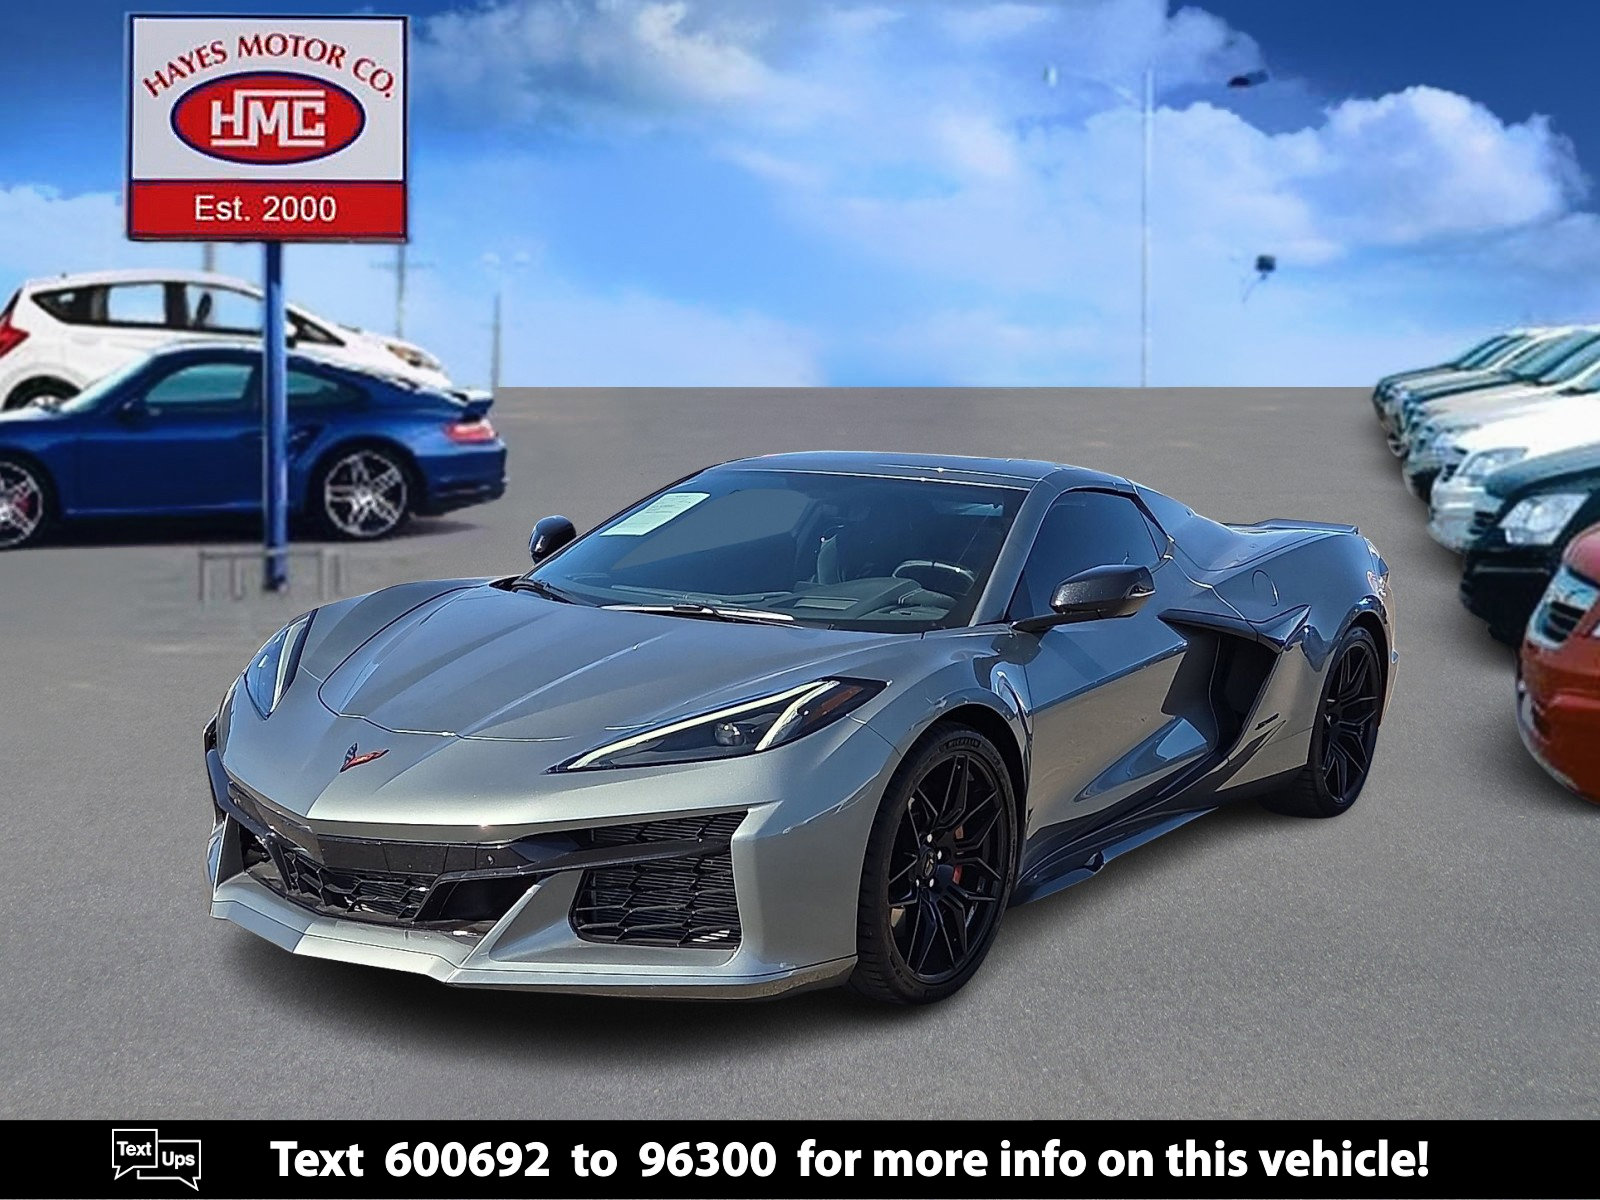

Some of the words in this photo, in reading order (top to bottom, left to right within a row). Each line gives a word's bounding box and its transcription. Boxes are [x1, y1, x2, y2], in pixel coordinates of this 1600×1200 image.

[143, 41, 228, 98] HAYES
[238, 33, 347, 70] MOTOR
[353, 57, 394, 99] CO.
[210, 89, 326, 147] HMC
[195, 194, 251, 222] Est.
[262, 194, 337, 222] 2000
